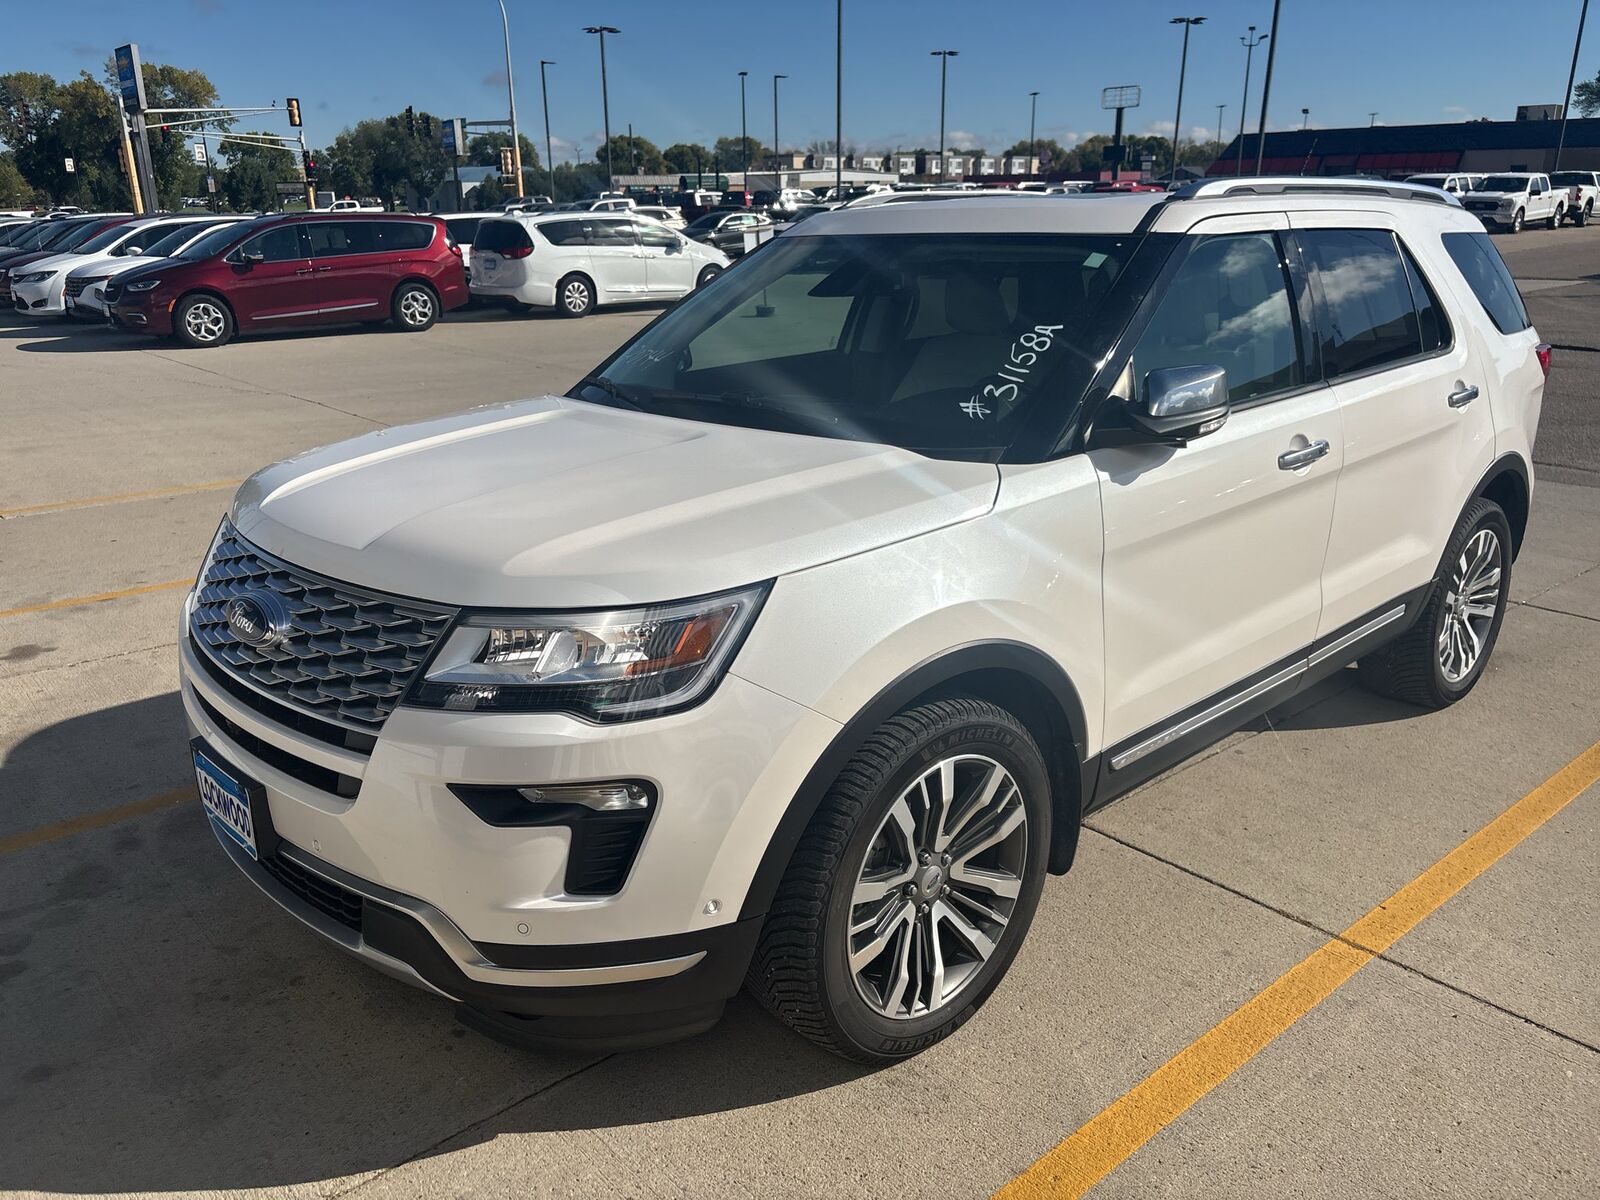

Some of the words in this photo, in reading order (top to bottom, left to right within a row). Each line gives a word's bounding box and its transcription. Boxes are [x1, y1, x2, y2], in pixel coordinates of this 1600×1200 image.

[959, 324, 1064, 420] #31158A
[230, 601, 258, 634] Ford
[949, 727, 1014, 746] MICHELIN
[197, 770, 251, 839] LOCKWOOD
